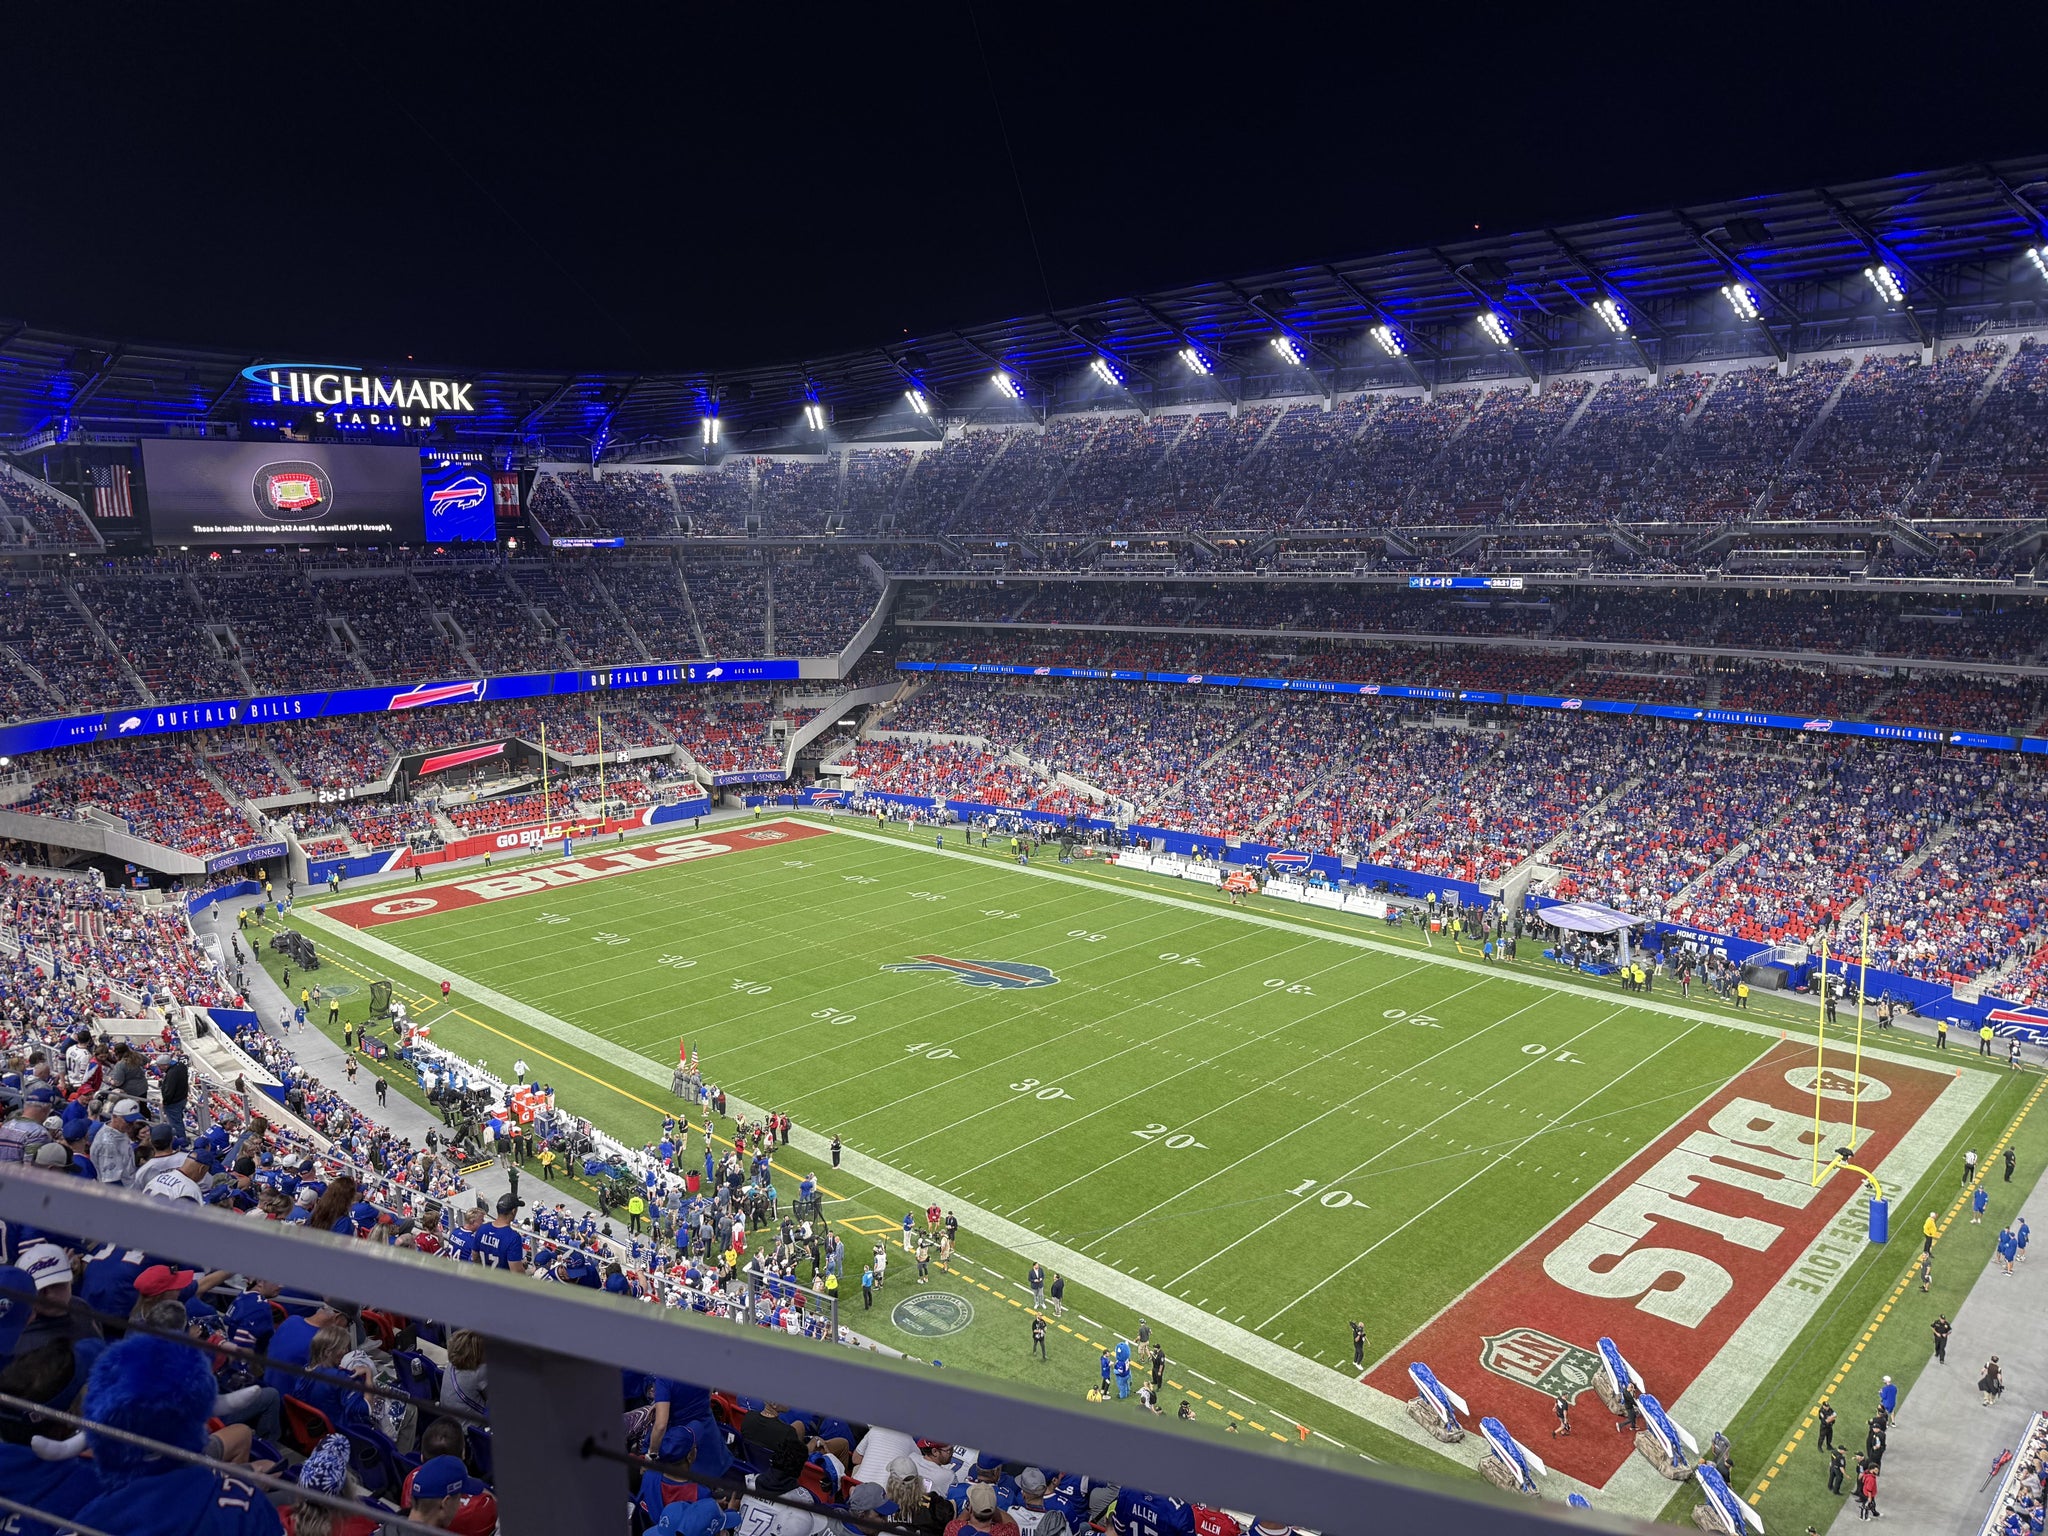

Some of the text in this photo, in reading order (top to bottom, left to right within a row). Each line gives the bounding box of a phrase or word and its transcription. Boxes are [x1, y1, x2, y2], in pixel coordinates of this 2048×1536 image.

[270, 371, 474, 411] HIGHMARK
[316, 412, 431, 427] STADIUM
[255, 525, 280, 533] through
[363, 524, 385, 532] through
[591, 671, 648, 687] BUFFALO
[657, 668, 696, 681] BILLS
[70, 700, 301, 735] AFC EAST BUFFALO BILLS
[1708, 712, 1767, 723] BUFFALO BILLS
[1875, 727, 1912, 737] BUFFALO
[1918, 731, 1944, 740] BILLS
[496, 834, 518, 848] GO
[253, 847, 282, 858] SENECA
[217, 856, 240, 867] SENECA
[454, 840, 732, 899] BILLS
[845, 875, 880, 884] 20
[913, 891, 947, 901] 30
[535, 912, 570, 924] 10
[984, 908, 1021, 919] 40
[592, 931, 630, 945] 20
[1066, 929, 1107, 942] 50
[1676, 929, 1725, 945] HOME OF THE
[658, 954, 697, 969] 30
[1158, 952, 1201, 966] 40
[731, 979, 772, 995] 40
[1263, 978, 1311, 995] 30
[811, 1007, 857, 1025] 50
[1382, 1008, 1438, 1027] 20
[905, 1041, 953, 1060] 40
[1521, 1043, 1579, 1063] 10
[1009, 1078, 1064, 1100] 30
[522, 1111, 530, 1120] G
[1130, 1123, 1197, 1149] 20
[156, 1173, 181, 1187] KELLY
[1285, 1179, 1355, 1208] 10
[1543, 1097, 1875, 1328] BILLS
[480, 1233, 500, 1249] ALLEN
[479, 1251, 500, 1270] 17
[1786, 1243, 1851, 1295] LOVE
[1493, 1333, 1566, 1378] NFL
[218, 1477, 254, 1512] 17
[998, 1486, 1010, 1498] 17
[741, 1503, 774, 1536] 17
[888, 1510, 912, 1524] ALLEN
[1132, 1503, 1158, 1525] ALLEN
[1200, 1519, 1222, 1535] ALLEN
